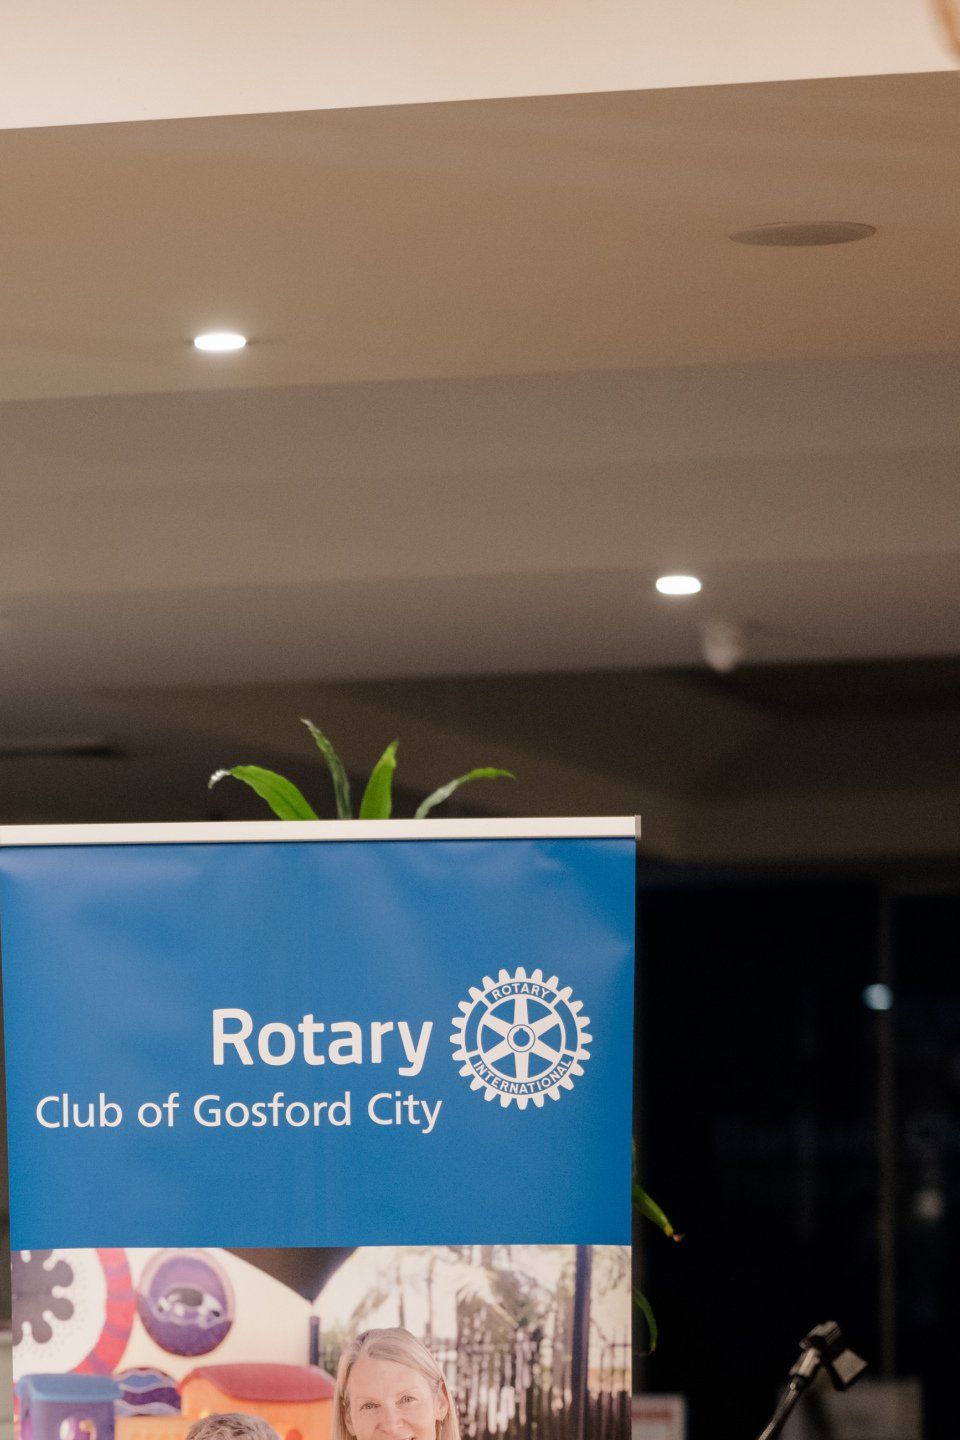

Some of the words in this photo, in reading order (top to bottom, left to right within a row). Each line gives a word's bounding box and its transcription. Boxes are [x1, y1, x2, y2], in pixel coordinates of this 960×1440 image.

[491, 983, 551, 1000] ROTARY
[212, 1007, 434, 1077] Rotary
[473, 1059, 572, 1094] INTERNATIONAL
[35, 1092, 124, 1129] Club
[137, 1091, 180, 1128] of
[193, 1090, 352, 1128] Gosford
[367, 1090, 443, 1135] City
